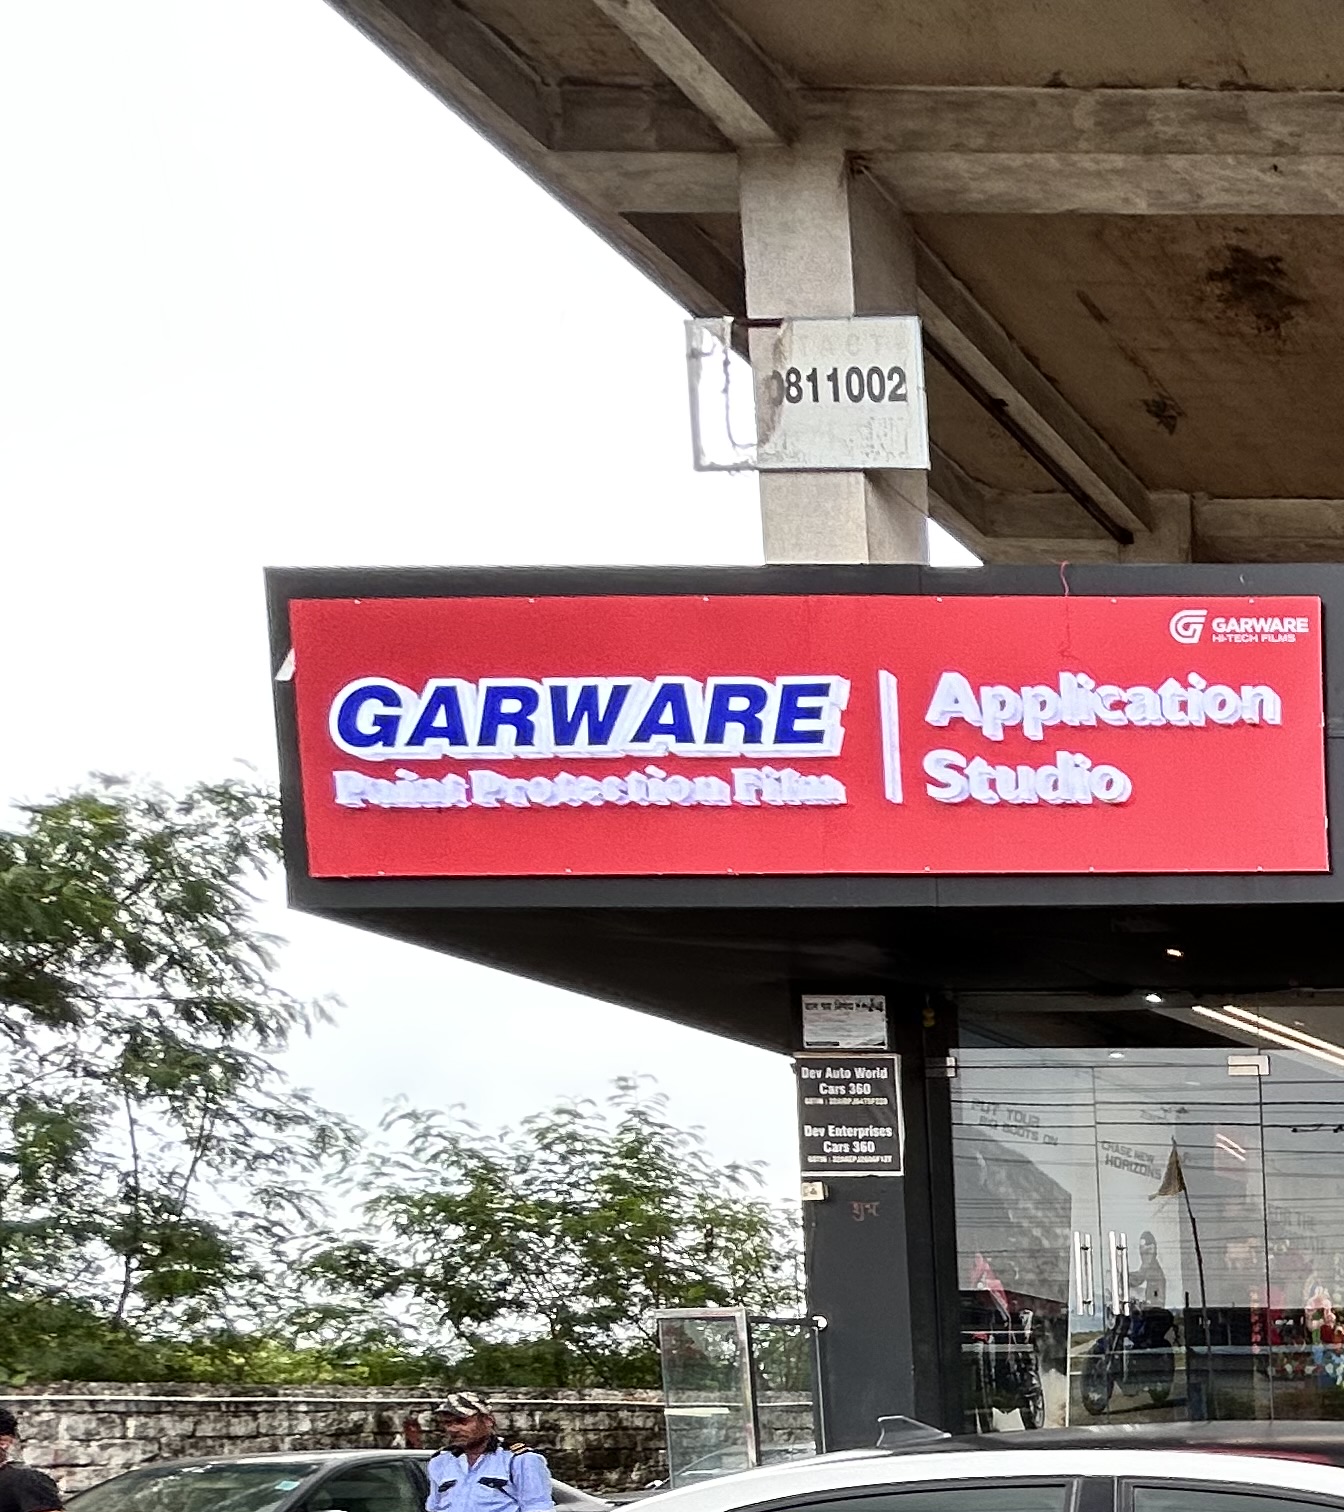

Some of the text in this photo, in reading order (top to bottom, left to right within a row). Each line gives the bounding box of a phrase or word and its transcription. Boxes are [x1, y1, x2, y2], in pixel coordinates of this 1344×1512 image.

[1212, 617, 1309, 633] GARWARE
[1212, 633, 1296, 643] HI-TECH FILMS
[925, 671, 1282, 740] Application
[331, 675, 846, 760] GARWARE
[923, 748, 1132, 804] Studio
[468, 765, 733, 807] Protection
[731, 765, 847, 806] Film
[801, 1067, 888, 1079] Dev Auto World
[819, 1083, 871, 1095] Cars 360
[804, 1125, 892, 1139] Dev Enterprises
[823, 1141, 875, 1152] Cars 360
